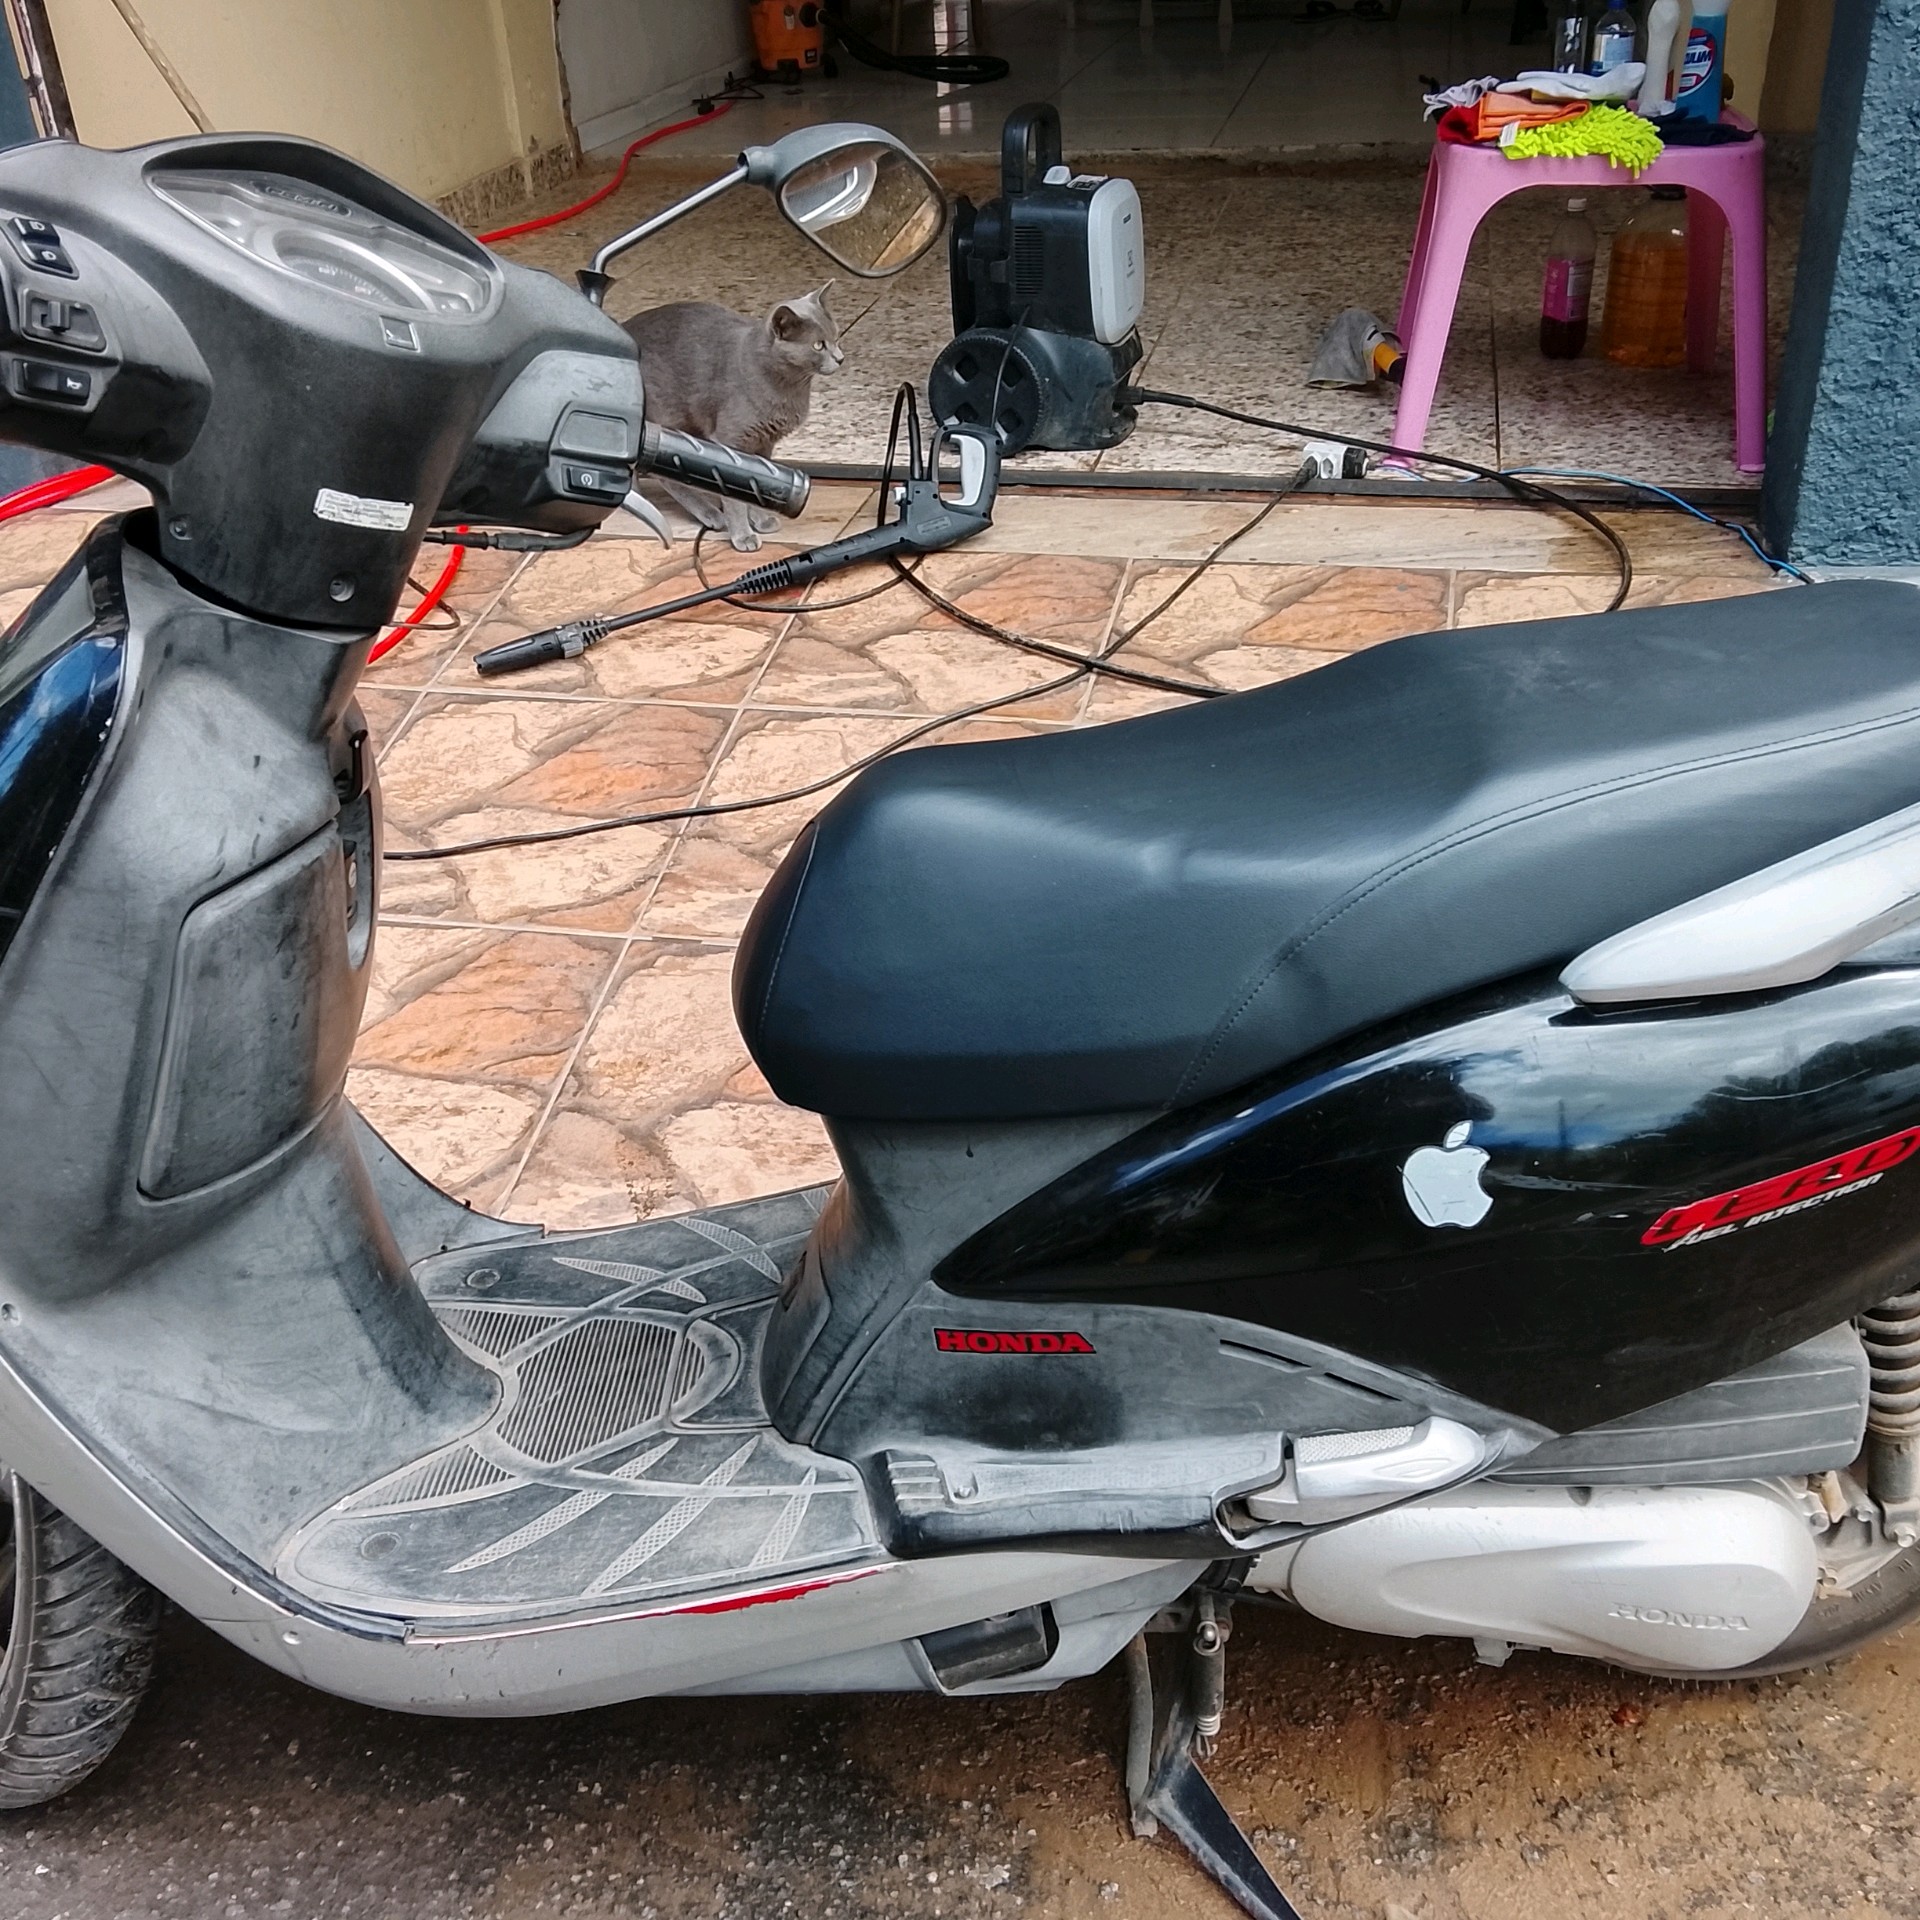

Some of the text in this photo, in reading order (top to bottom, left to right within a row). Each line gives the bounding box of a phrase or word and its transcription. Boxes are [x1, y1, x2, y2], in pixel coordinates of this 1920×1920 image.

[1653, 1134, 1917, 1238] LEAD
[1662, 1173, 1884, 1253] FUEL INJECTION
[936, 1330, 1094, 1353] HONDA
[1608, 1603, 1750, 1630] HONDA
